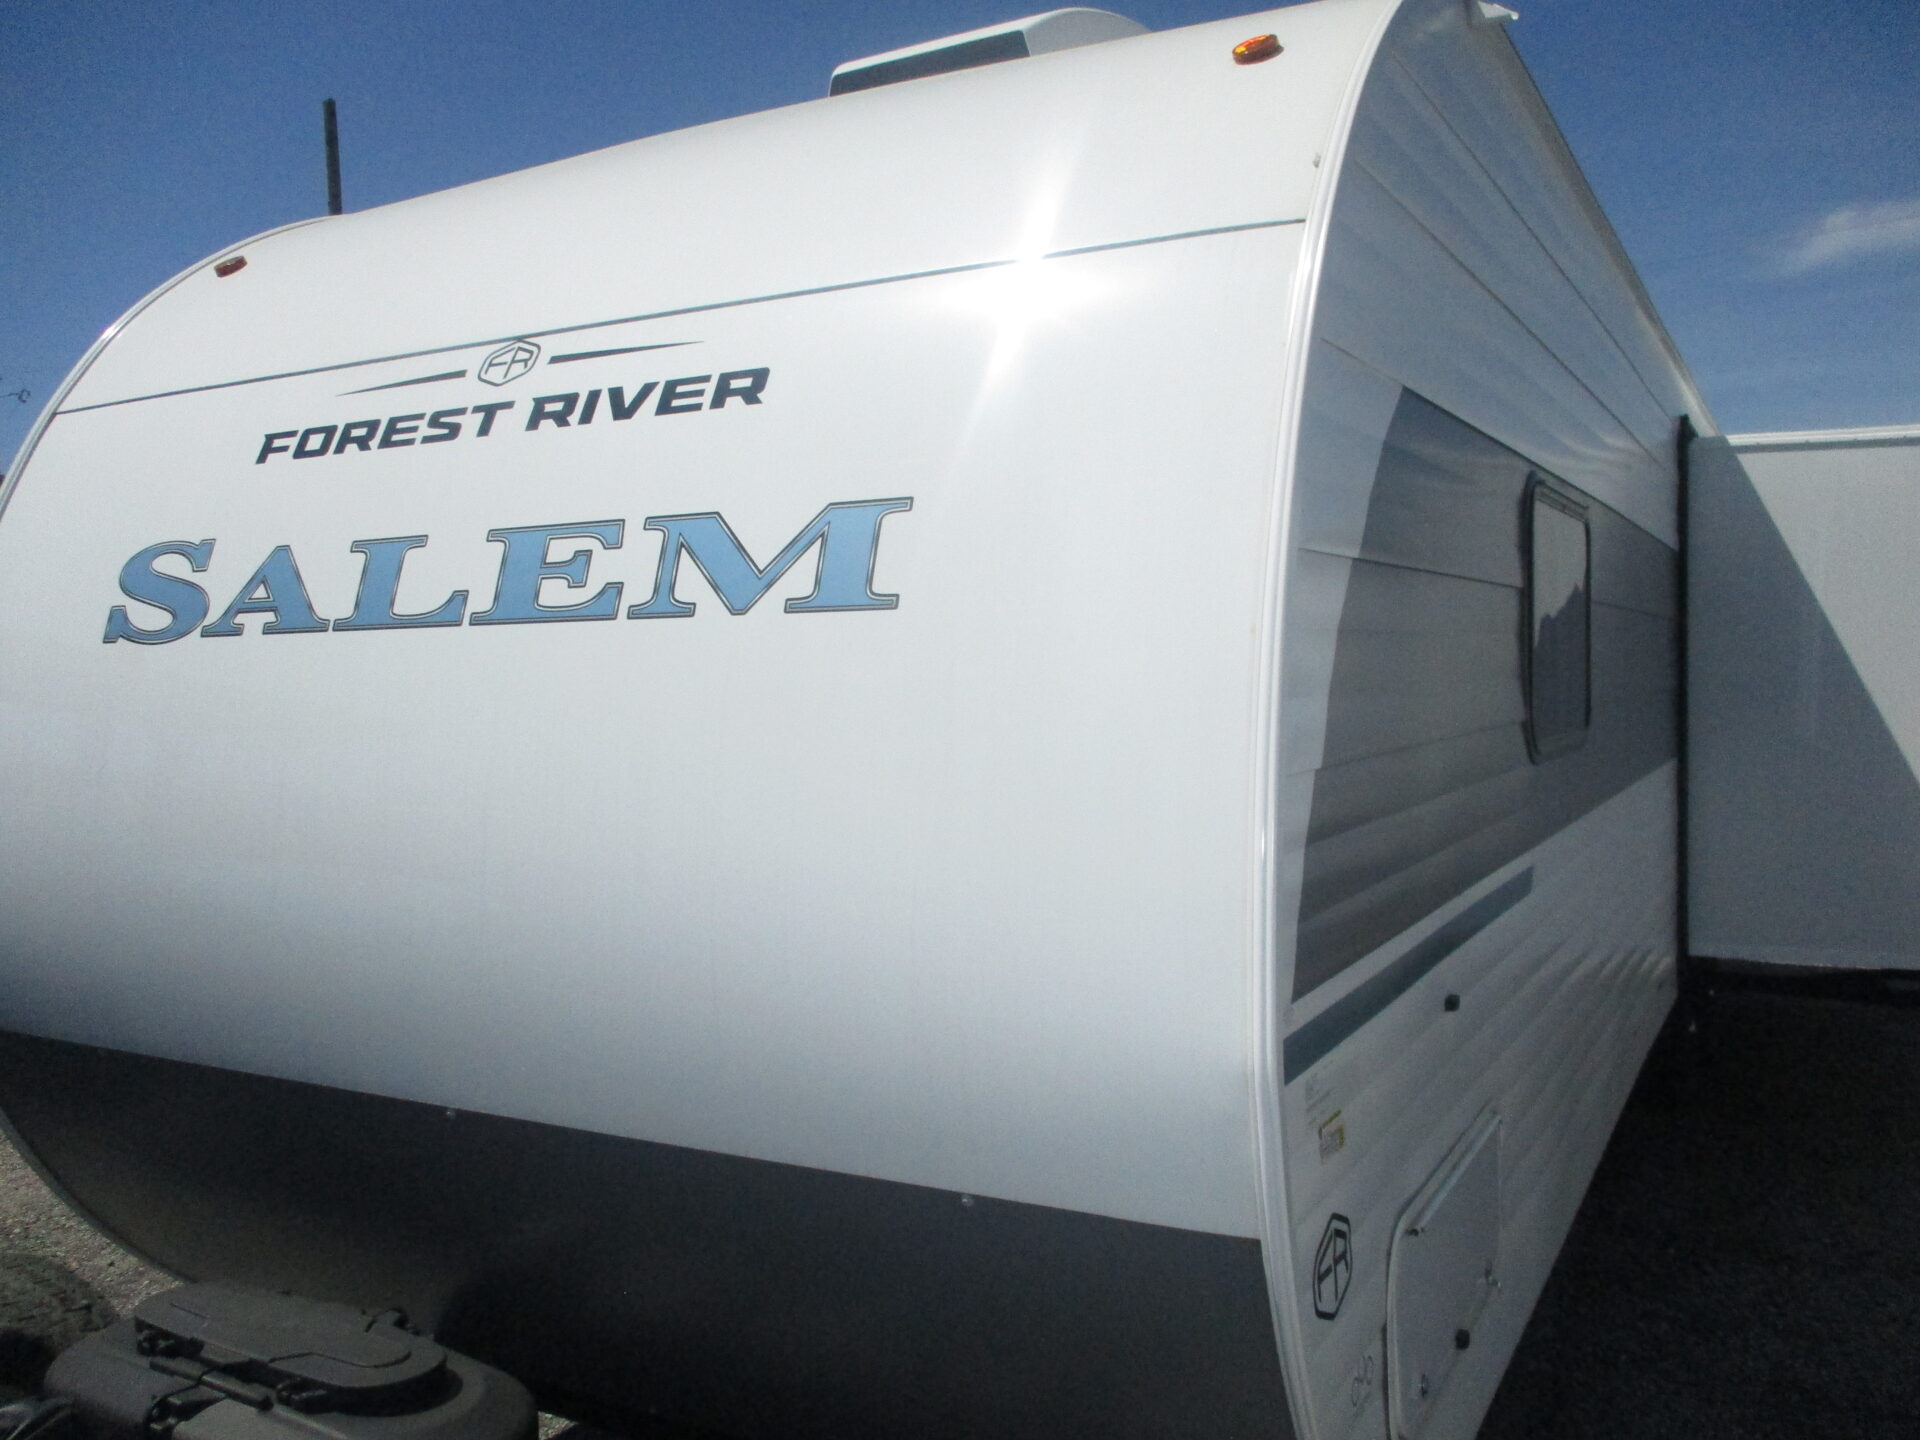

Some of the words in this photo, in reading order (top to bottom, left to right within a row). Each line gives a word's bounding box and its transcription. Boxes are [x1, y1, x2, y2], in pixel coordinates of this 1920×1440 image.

[255, 400, 516, 465] FOREST
[525, 367, 771, 432] RIVER
[102, 496, 914, 645] SALEM
